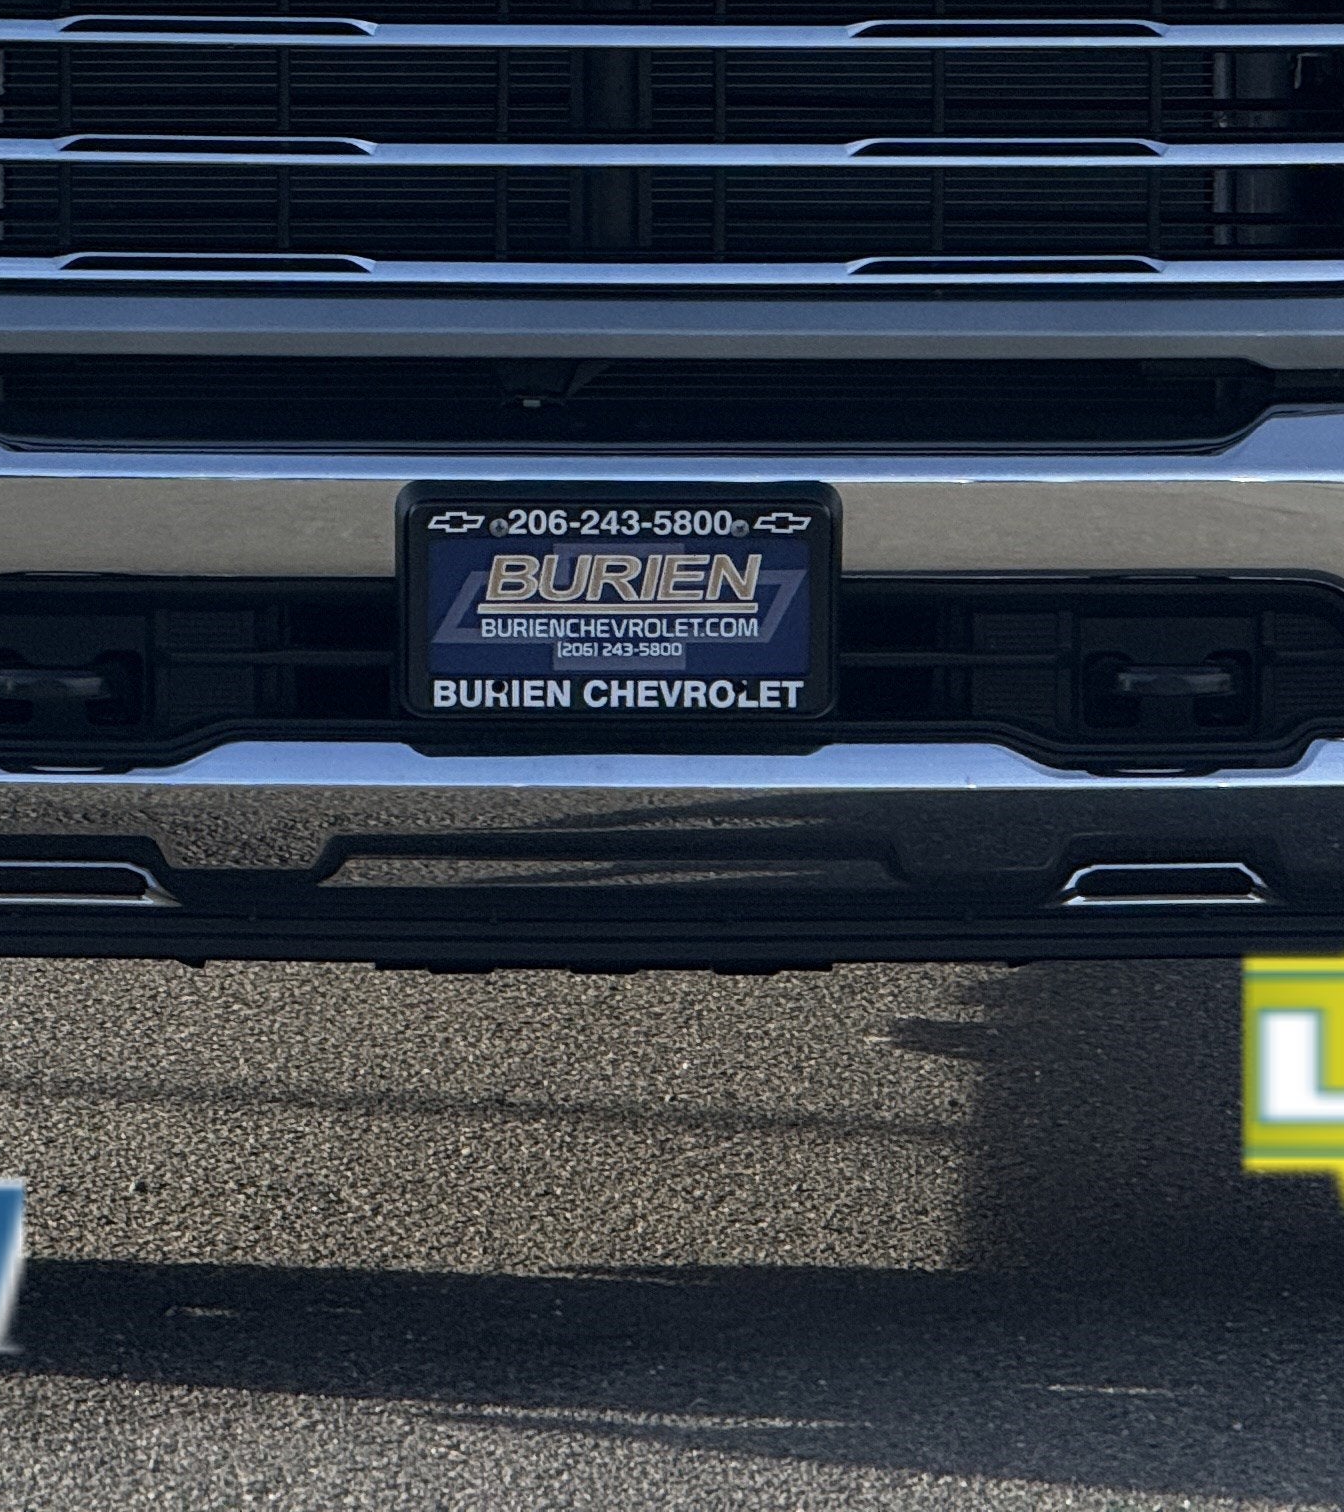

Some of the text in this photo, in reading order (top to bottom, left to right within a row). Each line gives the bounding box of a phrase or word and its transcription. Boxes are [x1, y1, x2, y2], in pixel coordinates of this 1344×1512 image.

[508, 510, 733, 536] 206-243-5800
[486, 554, 762, 601] BURIEN
[481, 618, 758, 638] BURIENCHEVROLET.COM
[603, 642, 683, 656] 243-5800
[433, 680, 804, 709] BURIEN CHEVROLET
